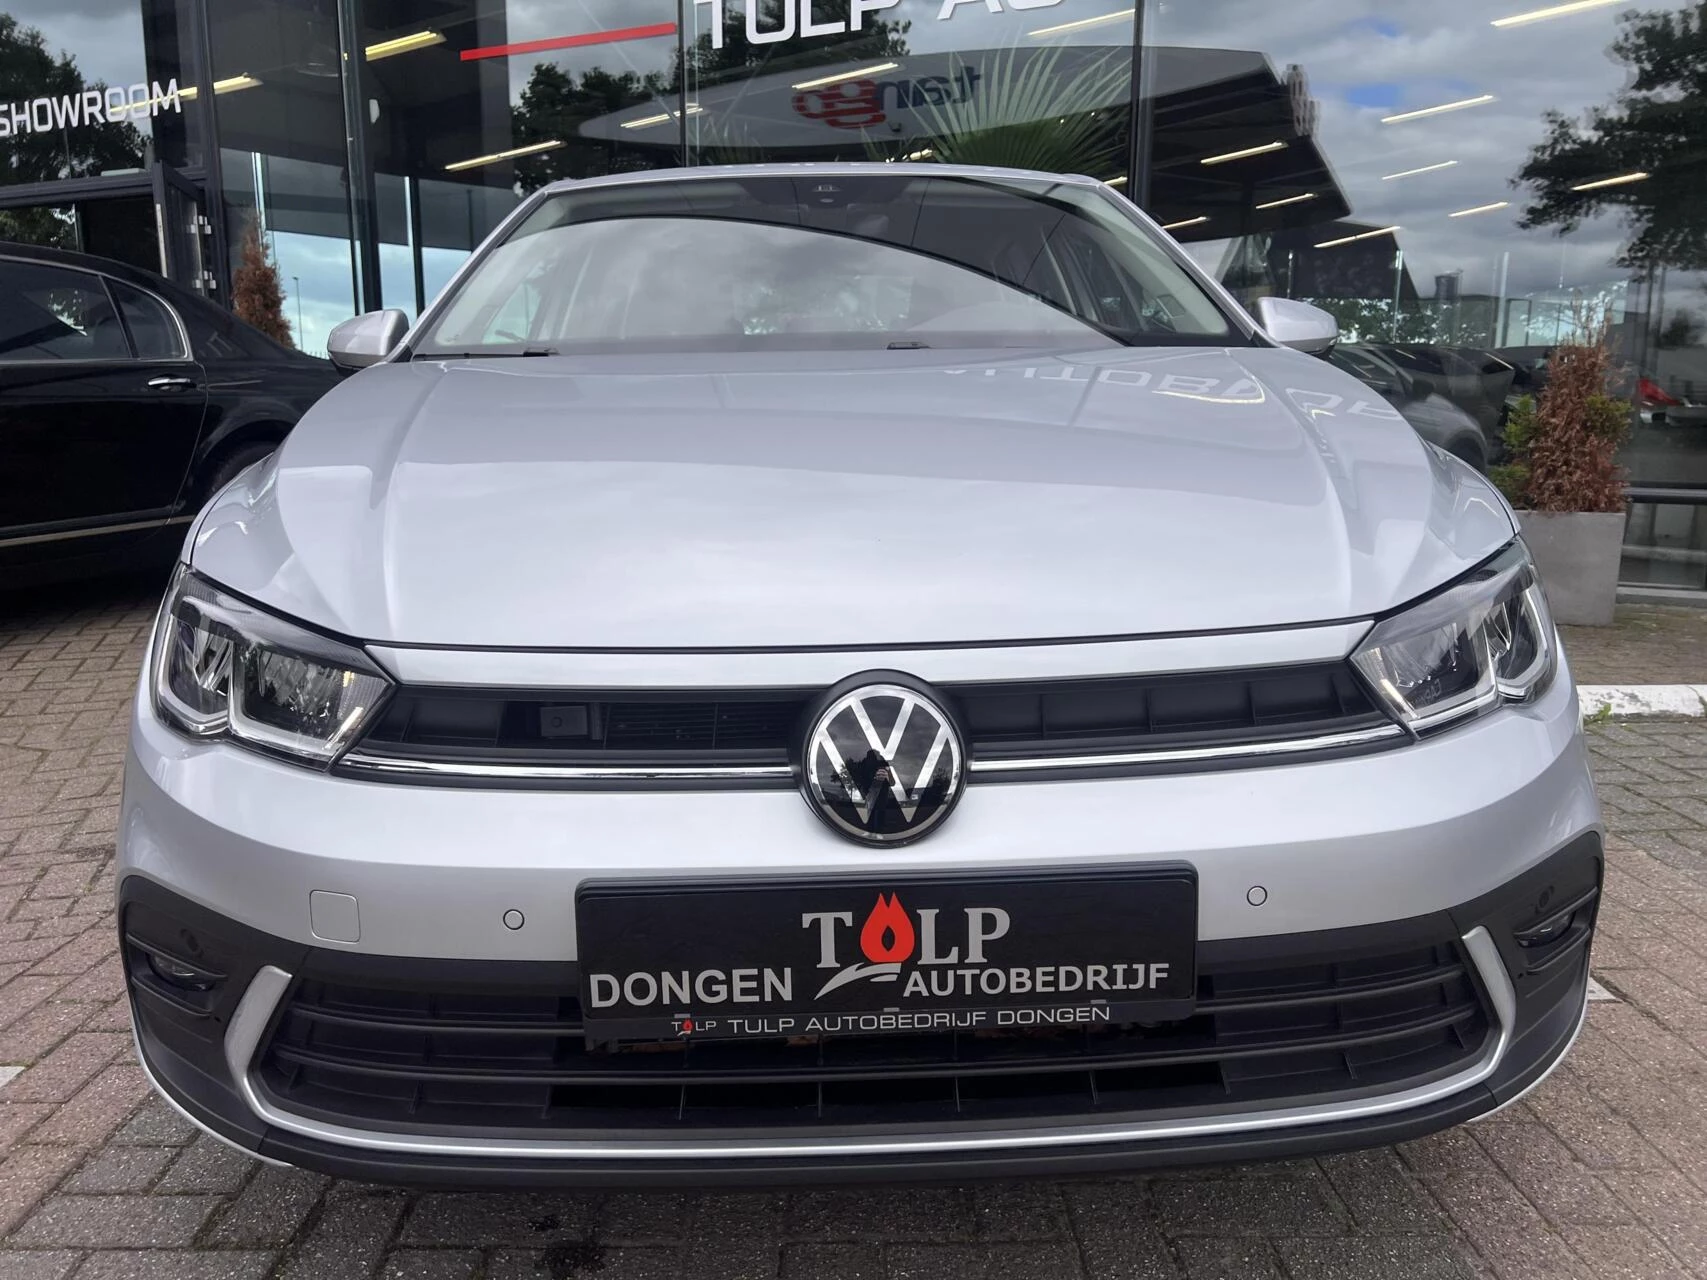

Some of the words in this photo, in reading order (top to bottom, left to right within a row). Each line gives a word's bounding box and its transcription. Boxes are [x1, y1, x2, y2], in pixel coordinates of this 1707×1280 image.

[0, 78, 182, 137] SHOWROOM
[589, 967, 793, 1008] DONGEN
[902, 963, 1170, 998] AUTOBEDRIJF
[727, 1017, 796, 1034] TULP
[805, 1011, 987, 1032] AUTOBEDRIJF
[997, 1006, 1111, 1025] DONGEN
